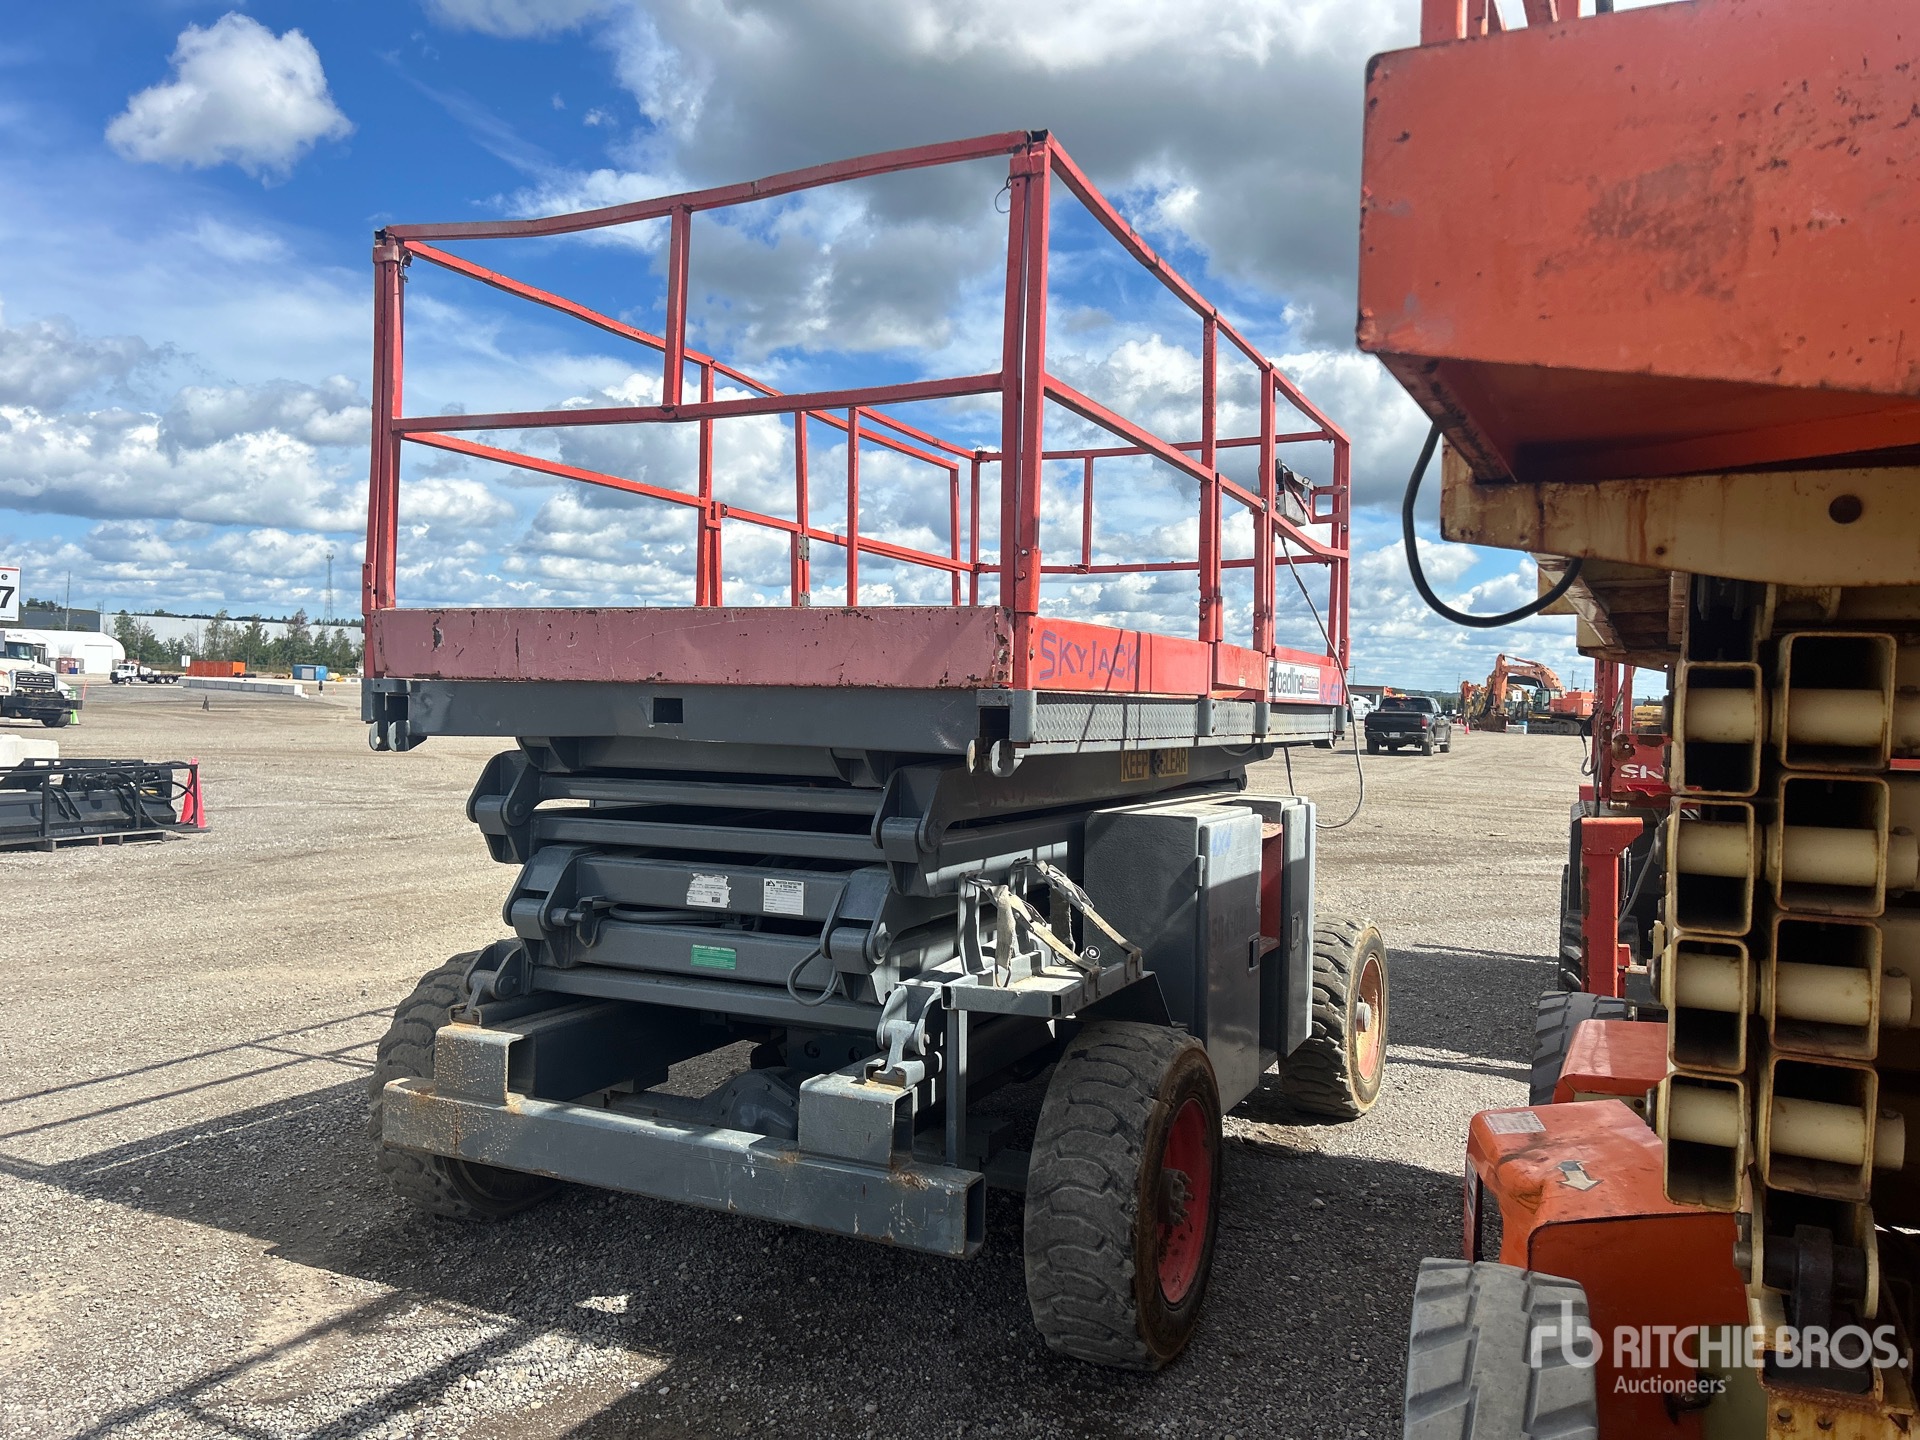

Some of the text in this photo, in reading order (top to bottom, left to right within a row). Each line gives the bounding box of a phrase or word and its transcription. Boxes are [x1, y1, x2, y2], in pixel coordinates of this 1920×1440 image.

[0, 586, 15, 608] 7
[1039, 629, 1139, 681] SKYJACK
[1123, 750, 1148, 779] KEEP
